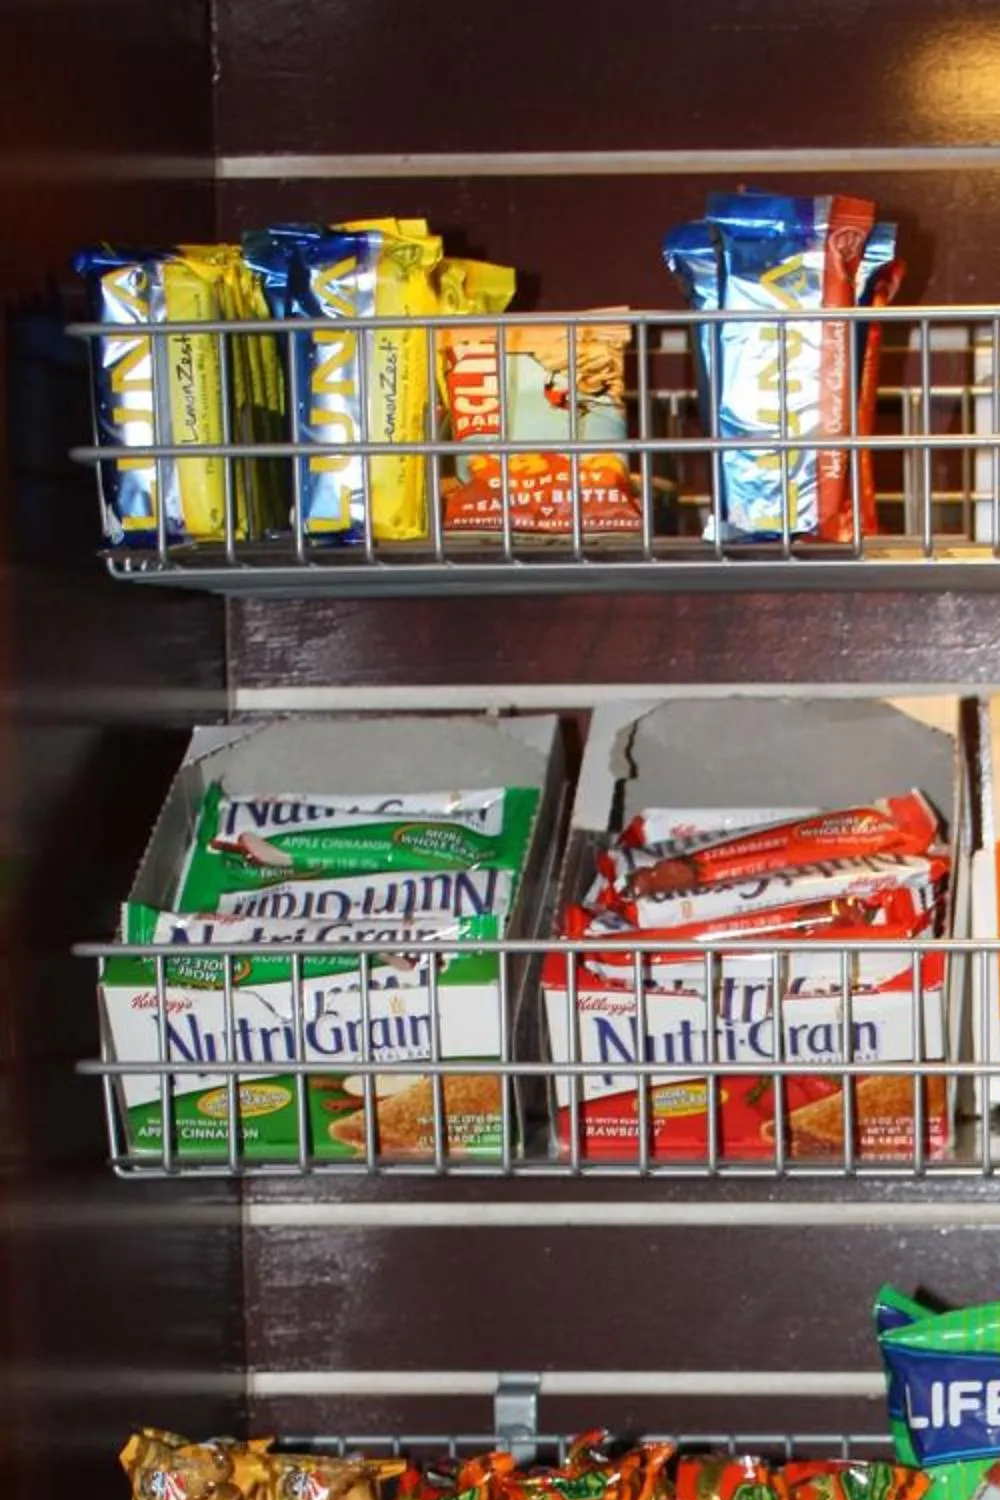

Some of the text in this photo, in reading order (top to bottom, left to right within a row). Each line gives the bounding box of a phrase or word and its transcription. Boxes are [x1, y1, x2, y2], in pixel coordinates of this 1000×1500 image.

[311, 257, 357, 533] LUNA
[377, 335, 403, 446] emonZest
[462, 487, 629, 511] EAUT BTTE
[154, 1011, 434, 1080] NutriGrain
[182, 1128, 259, 1139] CINNAON
